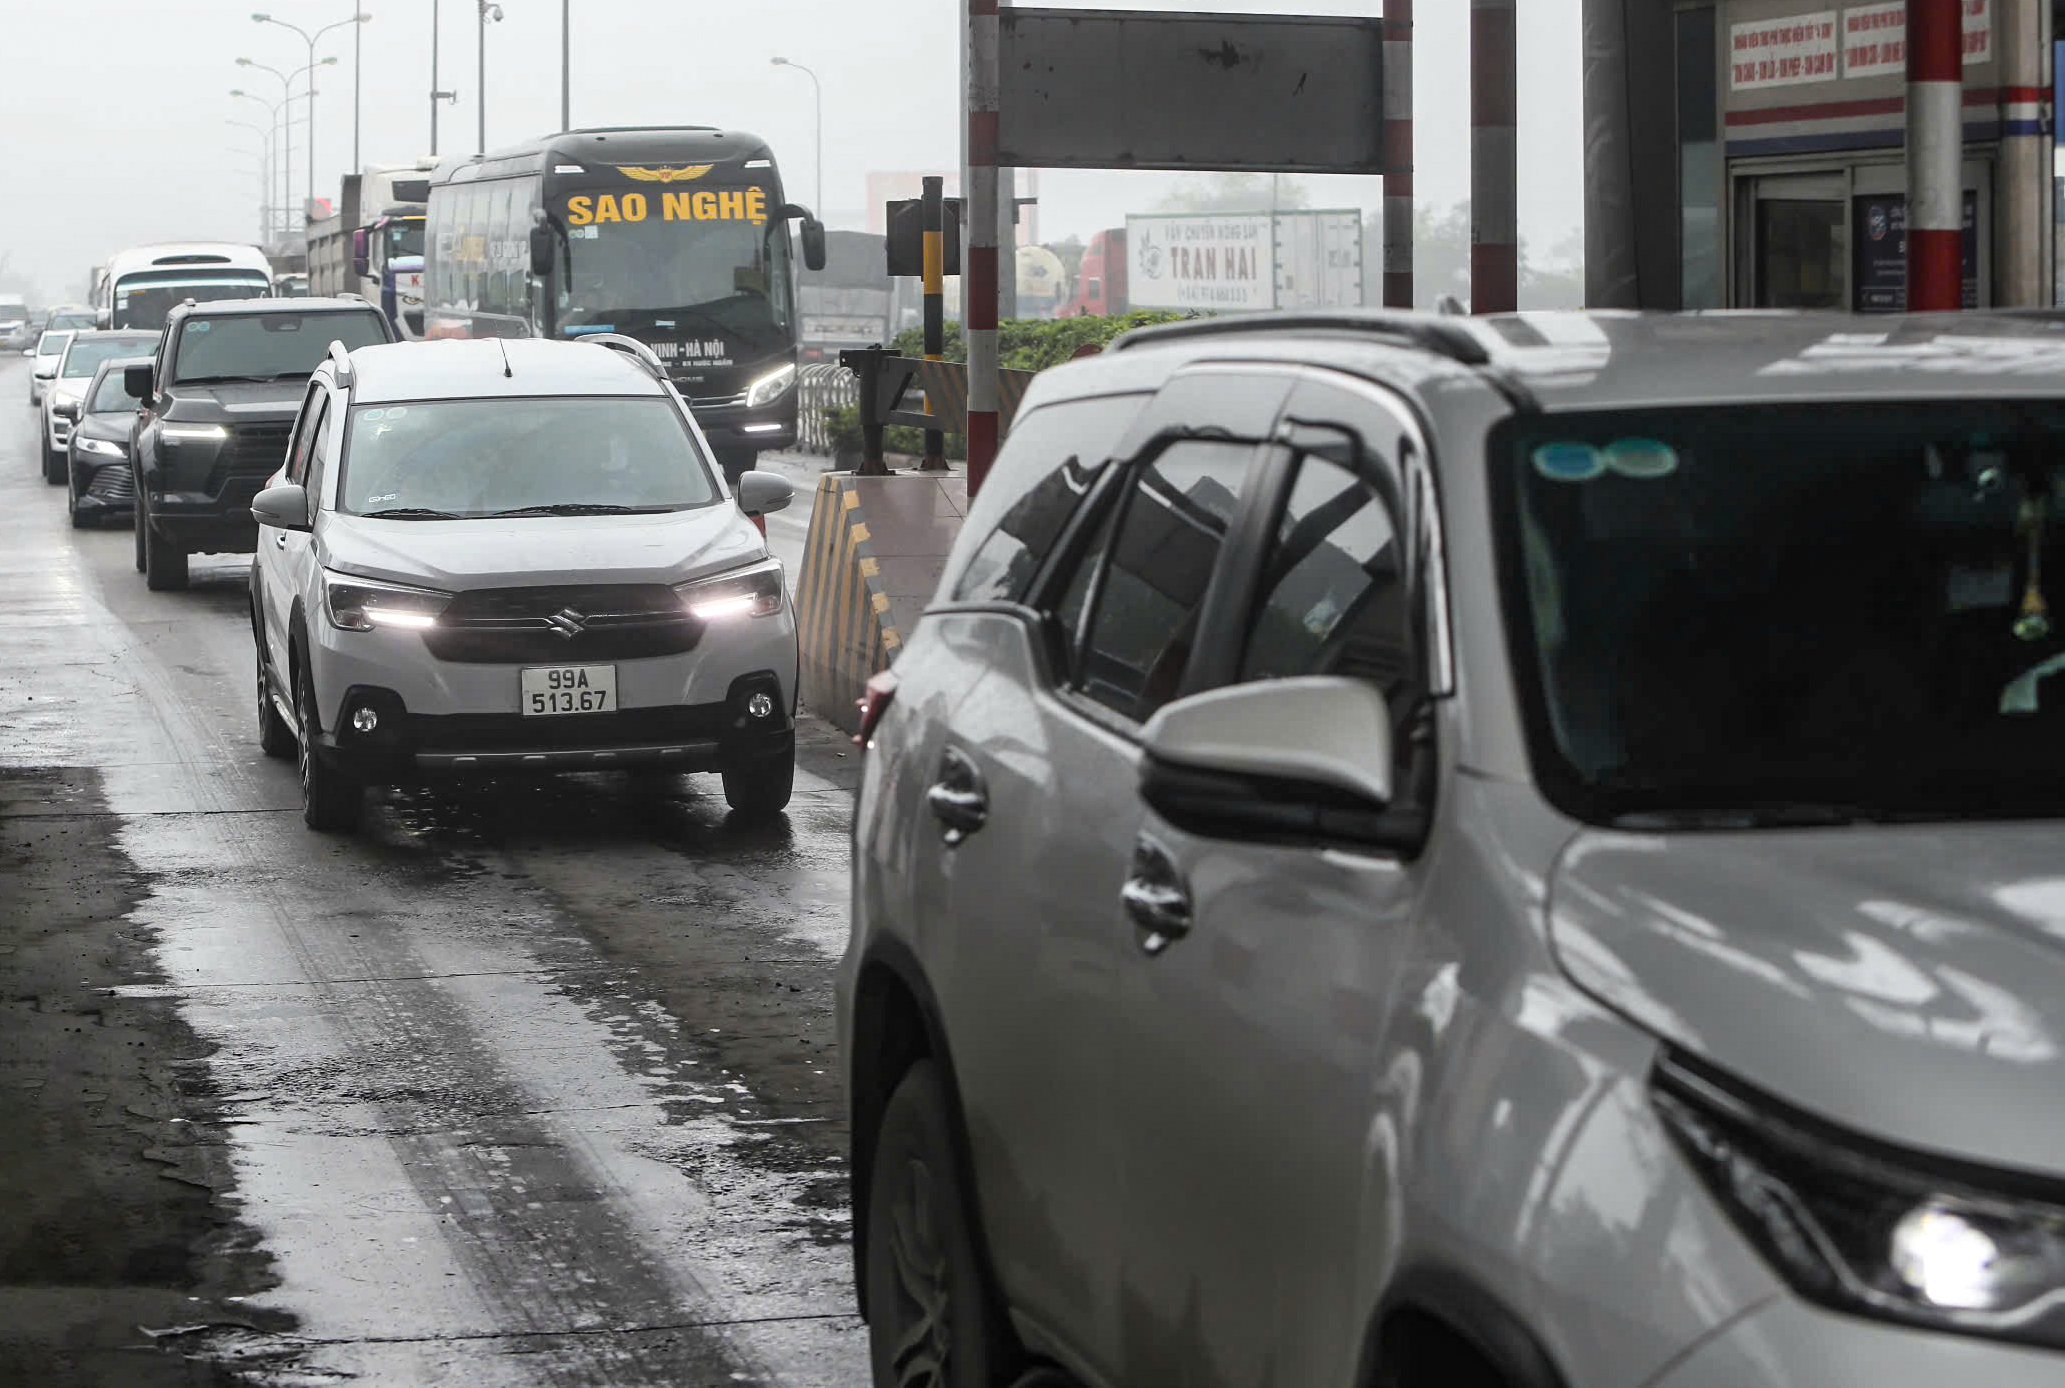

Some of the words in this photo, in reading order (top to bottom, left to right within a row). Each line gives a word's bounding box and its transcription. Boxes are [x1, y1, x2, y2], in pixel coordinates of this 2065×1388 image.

[567, 192, 647, 225] SAO
[662, 186, 768, 225] NGHỆ
[1225, 247, 1257, 280] HAI
[704, 338, 725, 359] NỘI
[548, 668, 589, 690] 99A
[532, 690, 607, 713] 513.67
